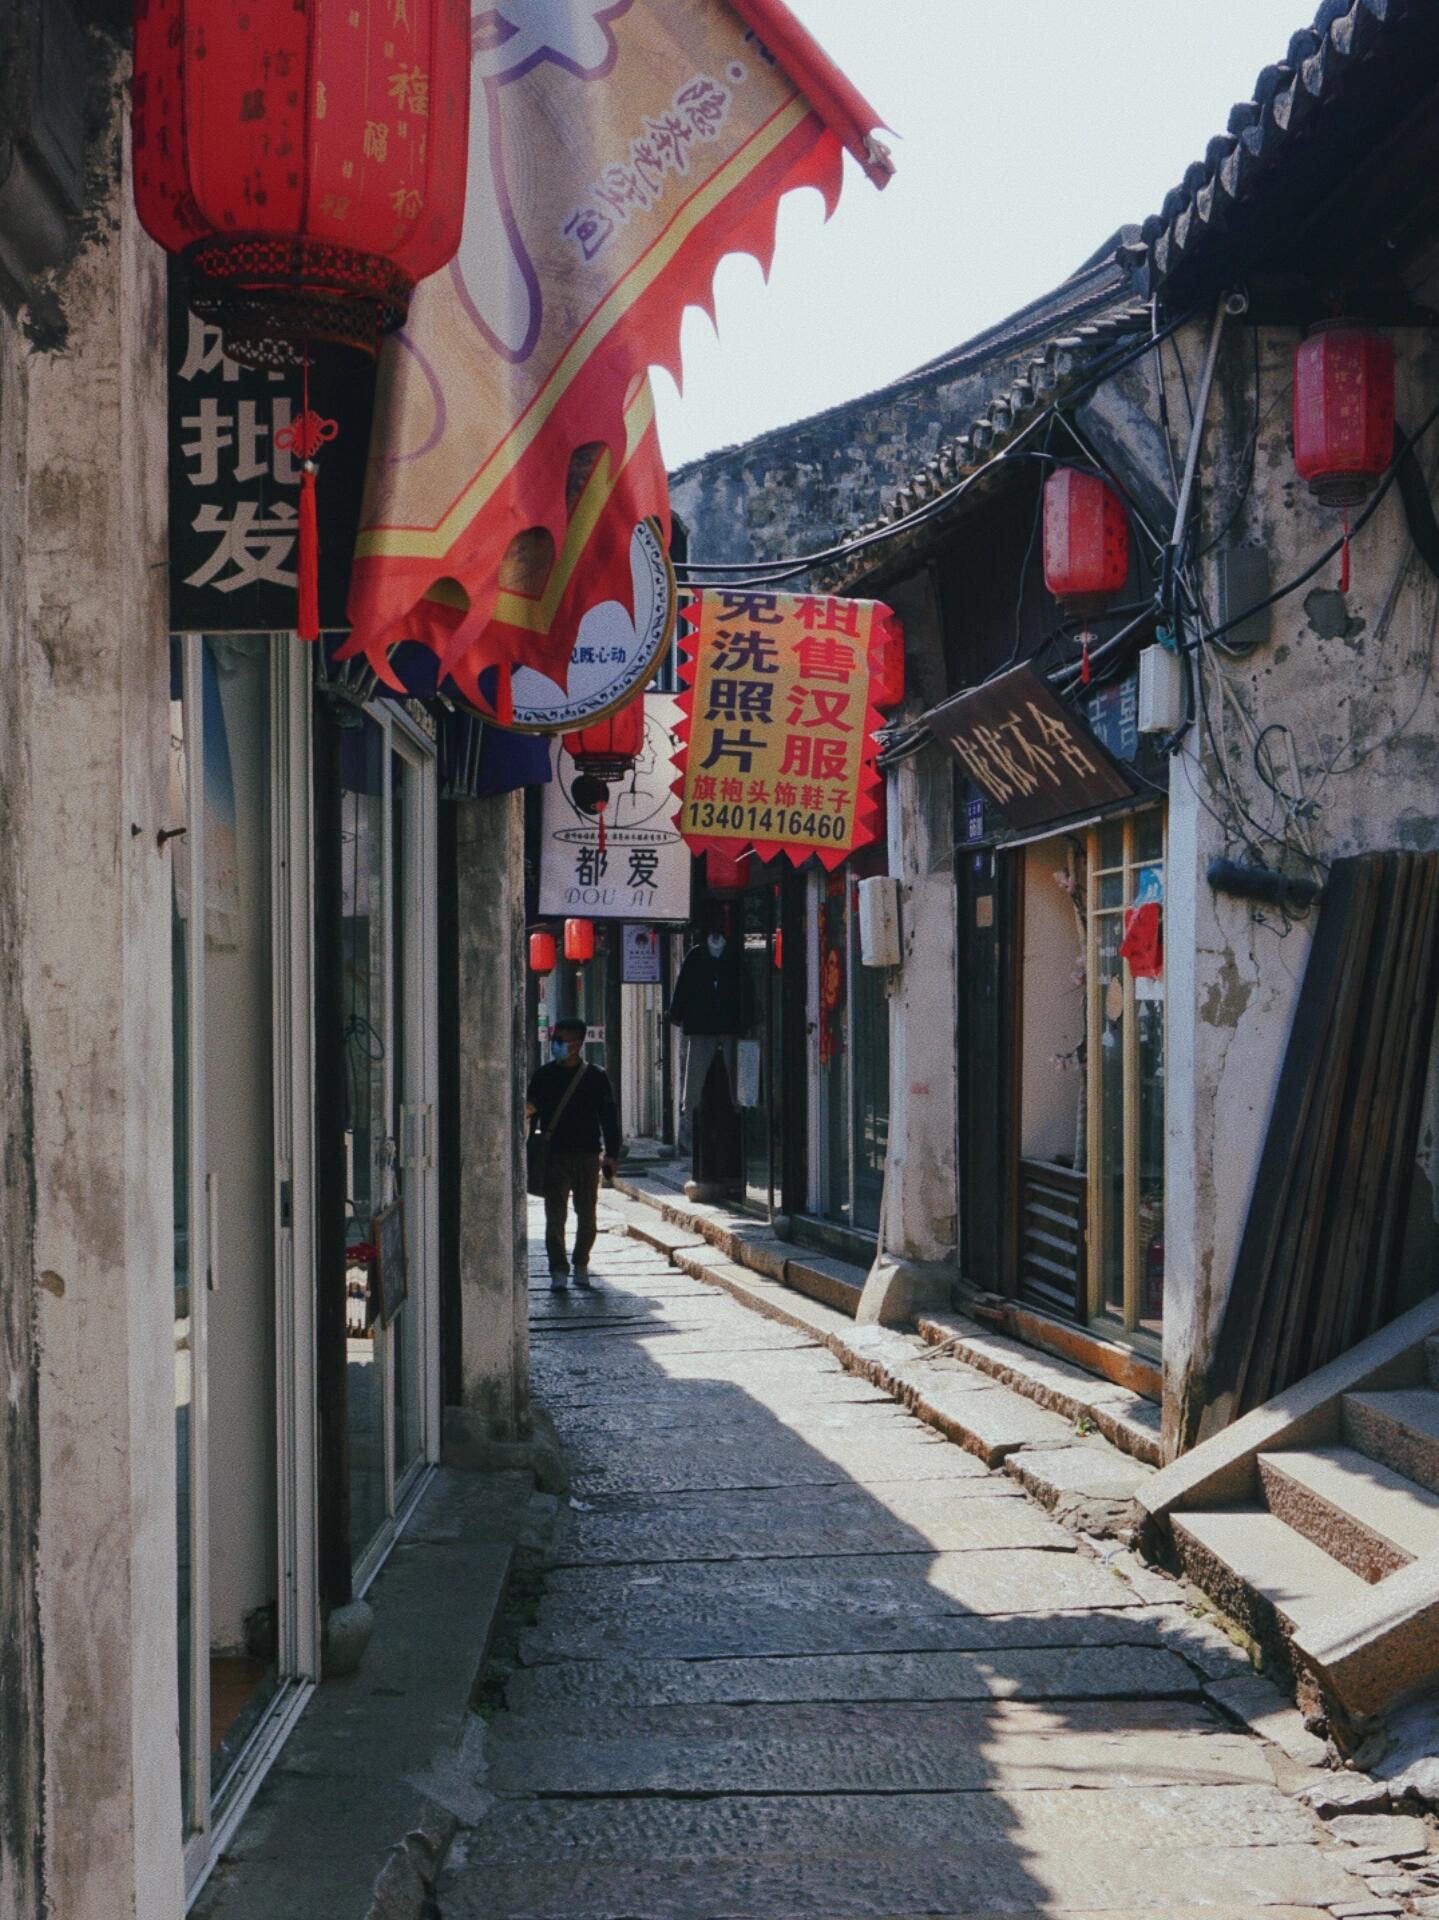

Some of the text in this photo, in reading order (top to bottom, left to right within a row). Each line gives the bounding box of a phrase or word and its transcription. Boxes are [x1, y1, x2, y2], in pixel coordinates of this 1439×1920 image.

[778, 596, 861, 782] 租售汉服
[692, 774, 851, 815] 旗袍头饰鞋子
[690, 803, 846, 841] 13401416460
[565, 888, 617, 905] DOU
